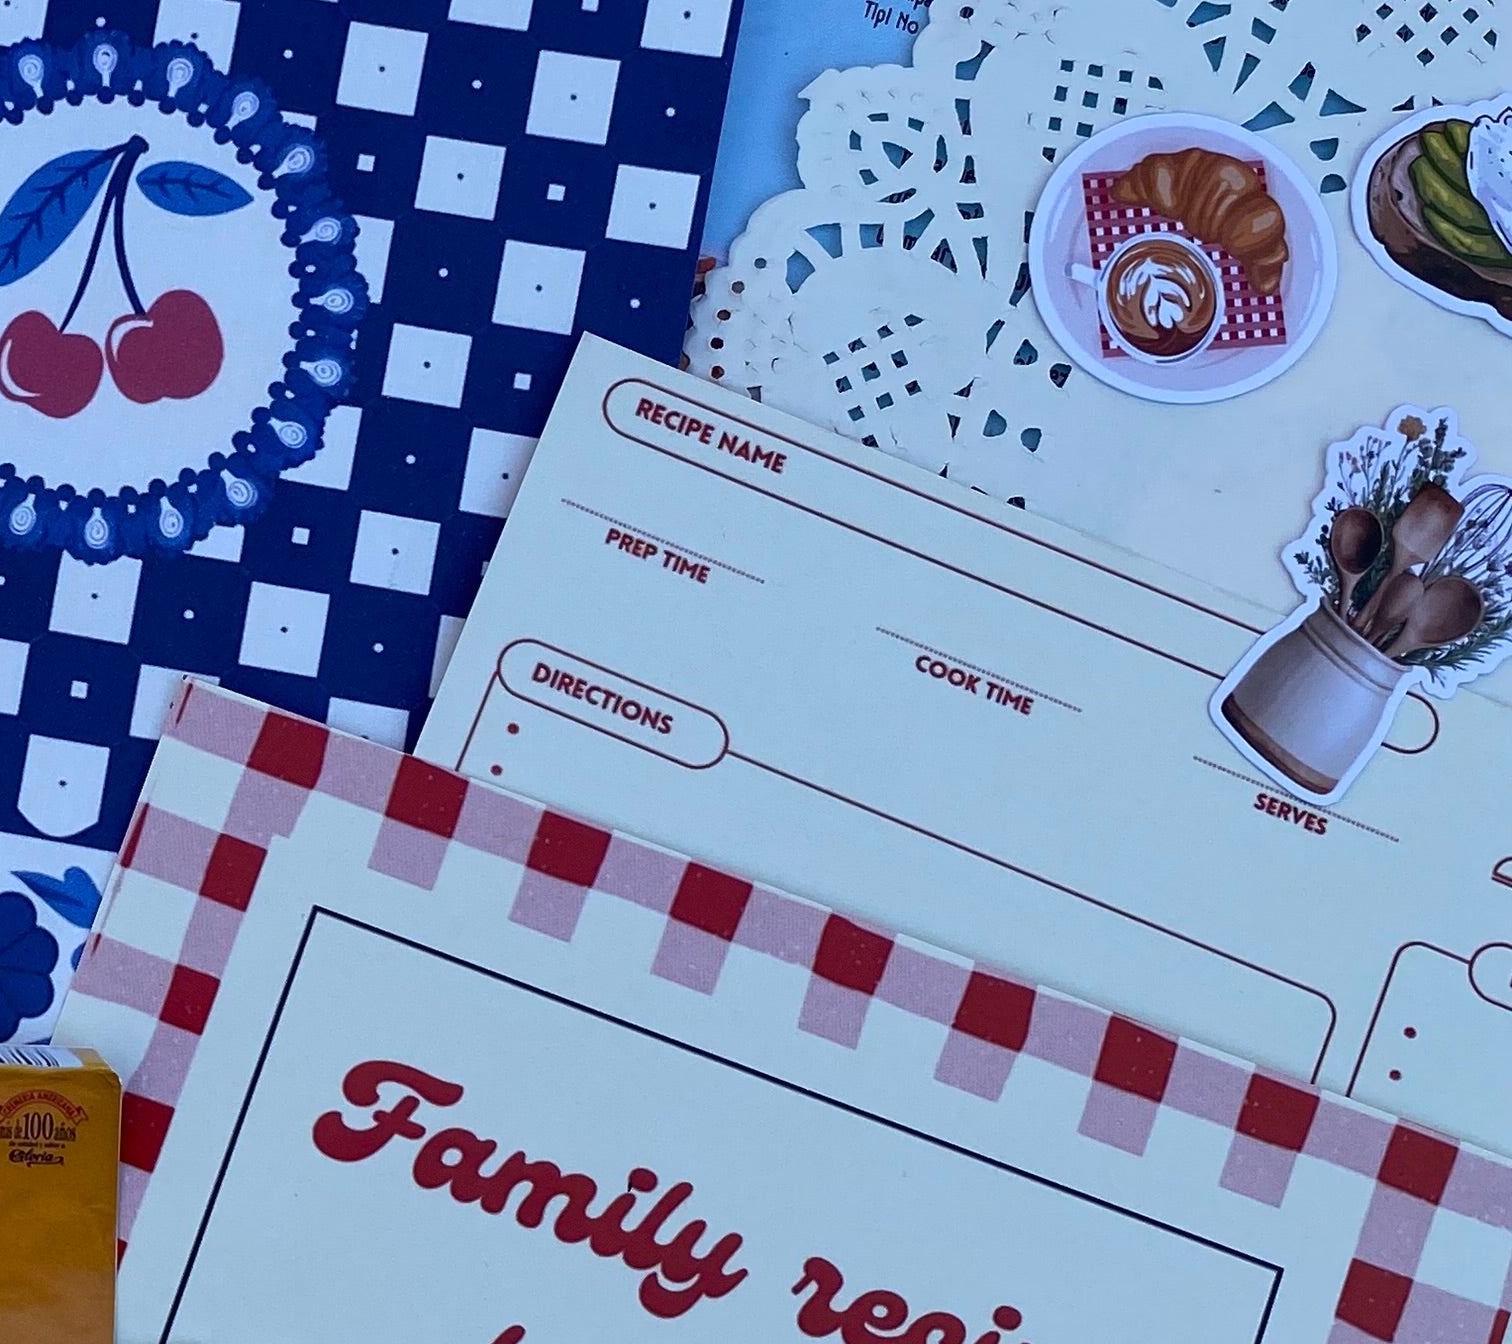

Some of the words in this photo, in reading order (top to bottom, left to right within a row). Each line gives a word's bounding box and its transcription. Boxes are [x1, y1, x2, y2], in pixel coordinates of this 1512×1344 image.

[895, 11, 919, 34] No
[632, 394, 716, 450] RECIPE
[717, 424, 791, 474] NAME
[605, 527, 658, 560] PREP
[662, 549, 712, 584] TIME
[528, 659, 677, 739] DIRECTIONS
[915, 652, 981, 694] COOK
[986, 679, 1034, 715] TIME
[1253, 789, 1331, 835] SERVES
[23, 1111, 54, 1140] 100
[312, 1060, 748, 1319] Family
